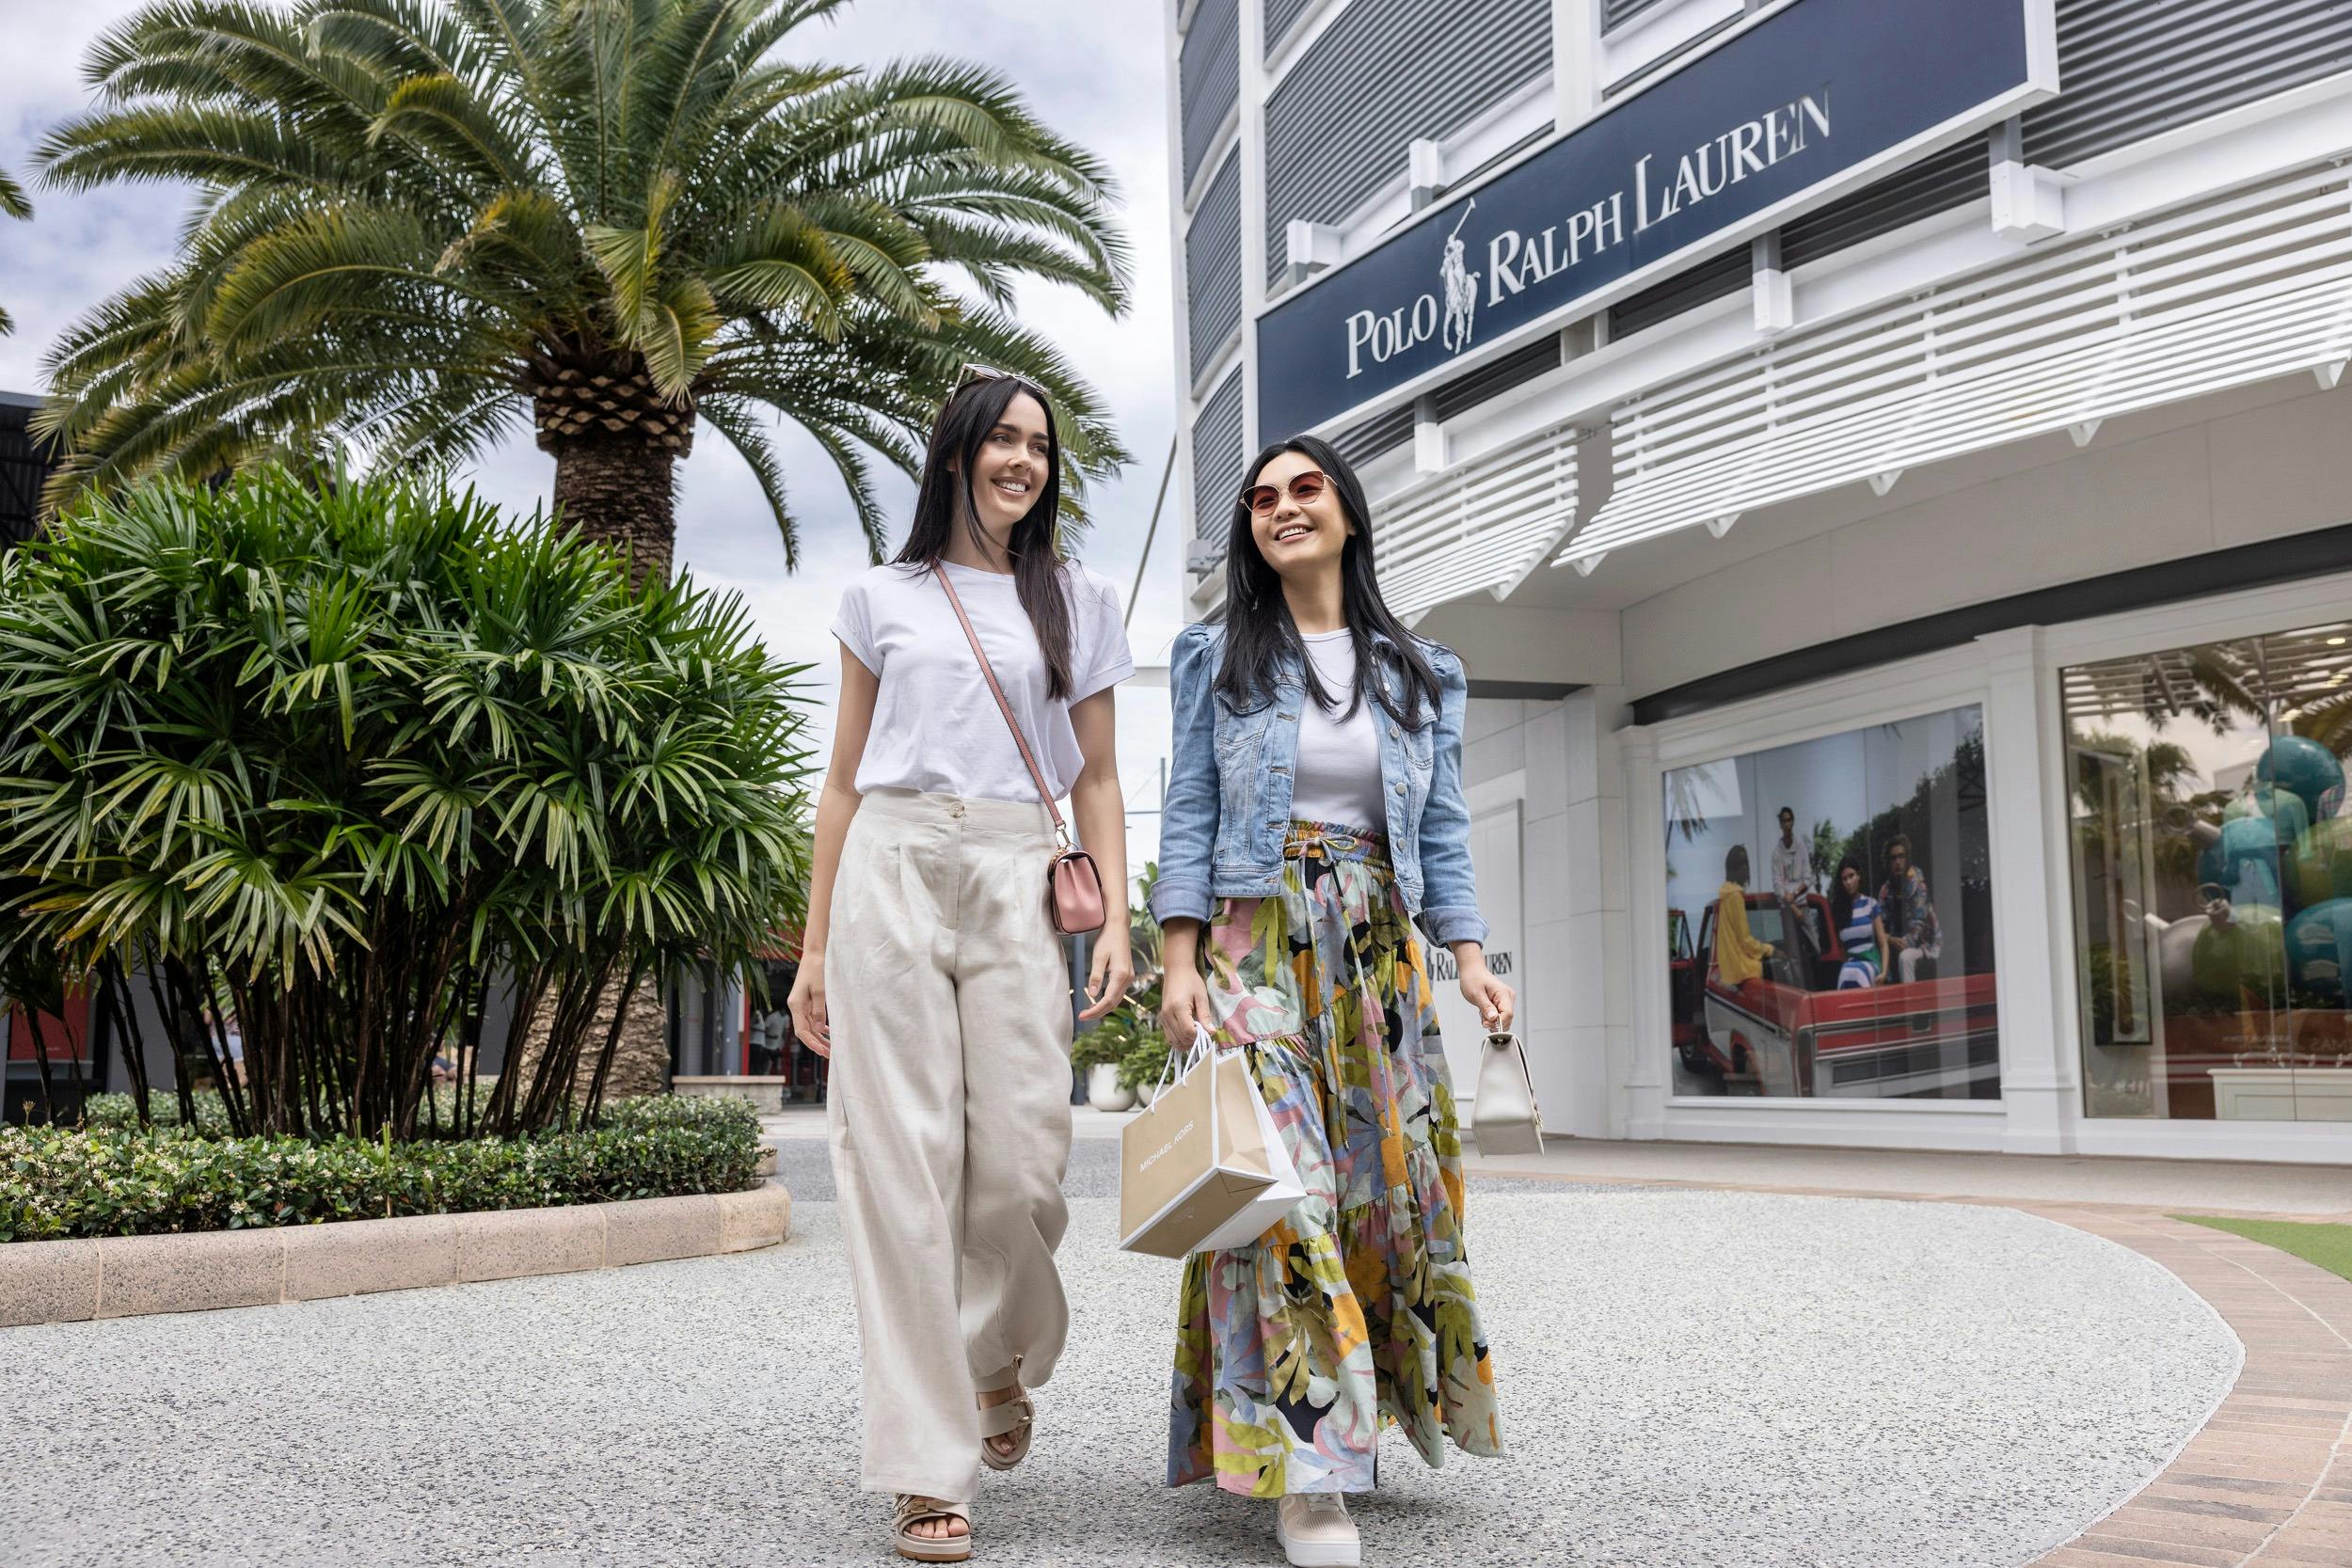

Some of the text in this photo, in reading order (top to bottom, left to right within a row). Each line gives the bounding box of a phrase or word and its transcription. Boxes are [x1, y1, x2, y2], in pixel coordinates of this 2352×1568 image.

[1345, 87, 1830, 379] POLO RALPH LAUREN
[1437, 952, 1459, 981] RAL
[1139, 1120, 1194, 1173] MICHAEL KORS
